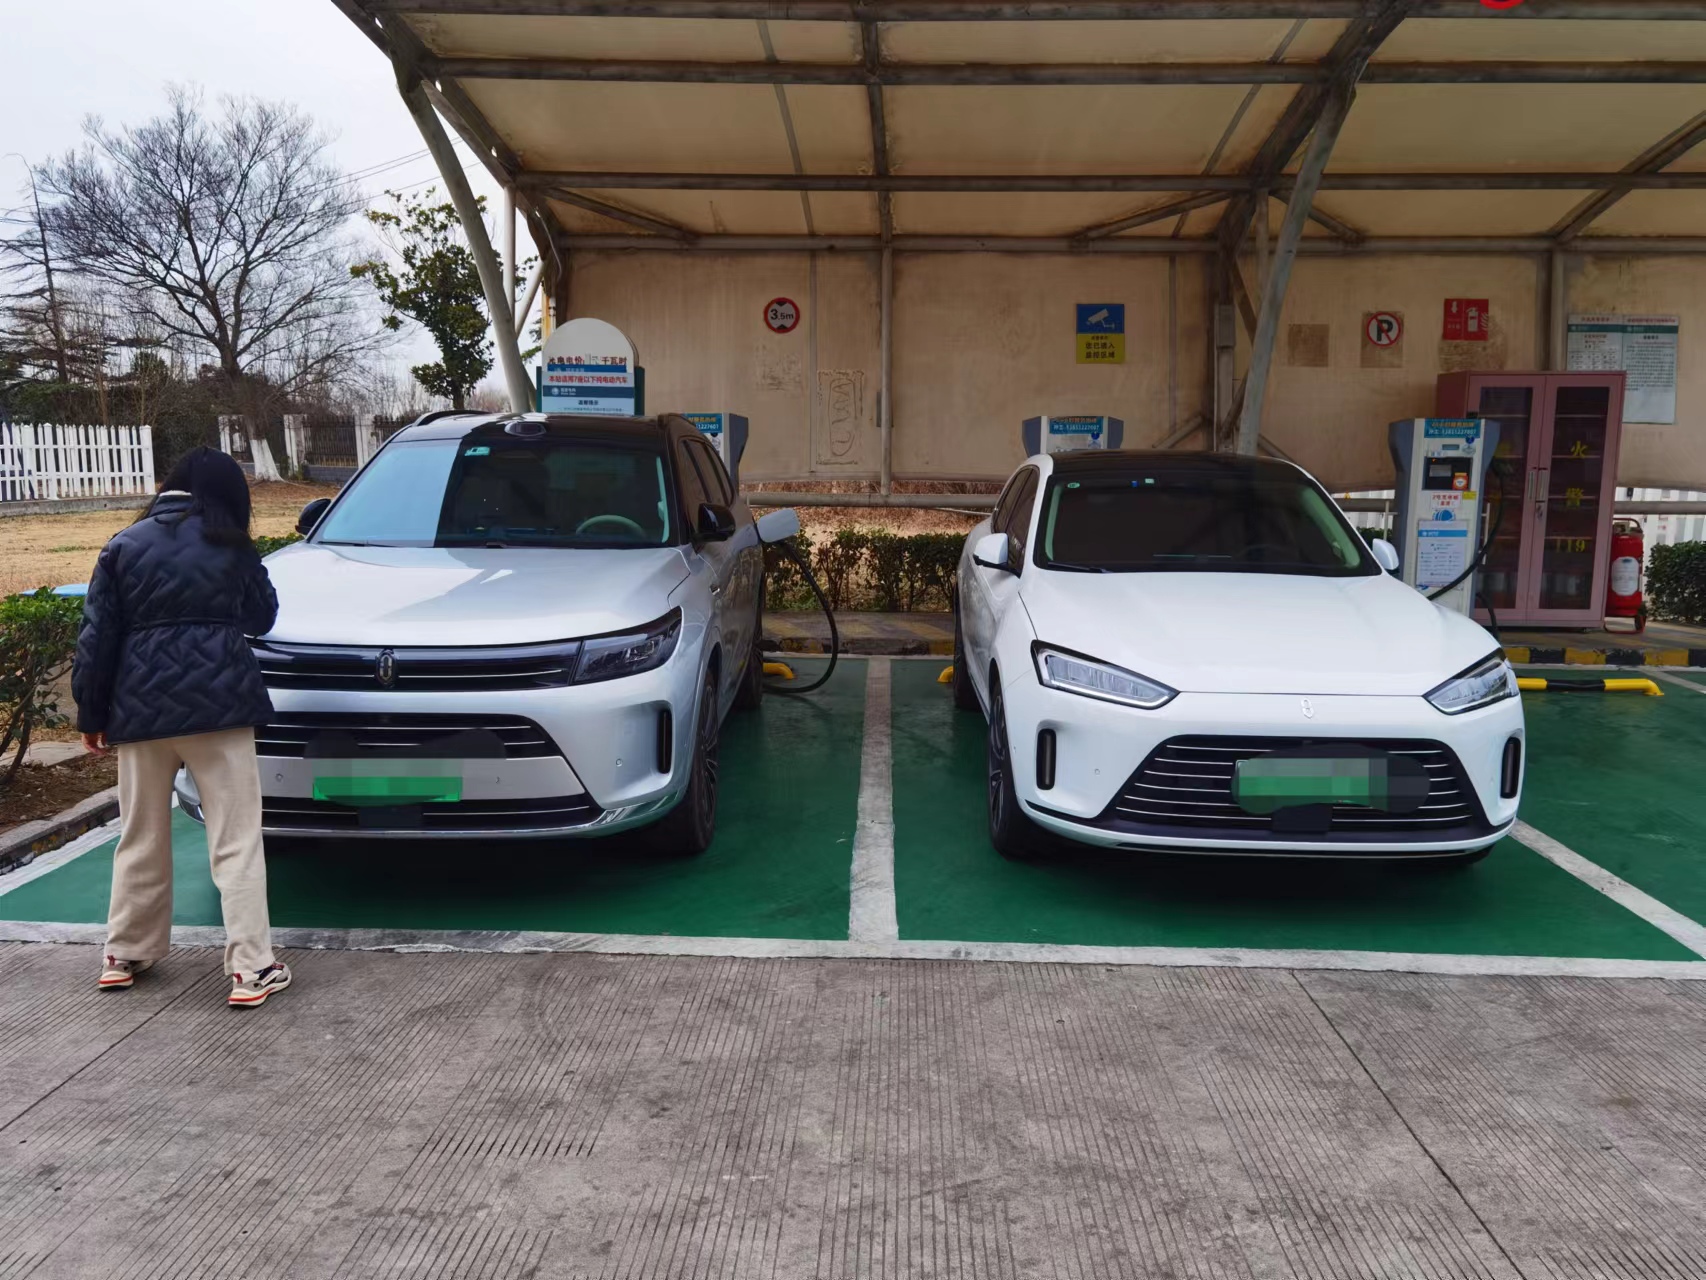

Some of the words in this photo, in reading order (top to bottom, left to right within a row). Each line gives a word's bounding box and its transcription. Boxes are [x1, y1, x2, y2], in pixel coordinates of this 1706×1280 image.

[770, 308, 794, 320] 3.5m
[1376, 319, 1394, 342] P
[1570, 440, 1588, 457] 火
[1556, 539, 1585, 553] 119
